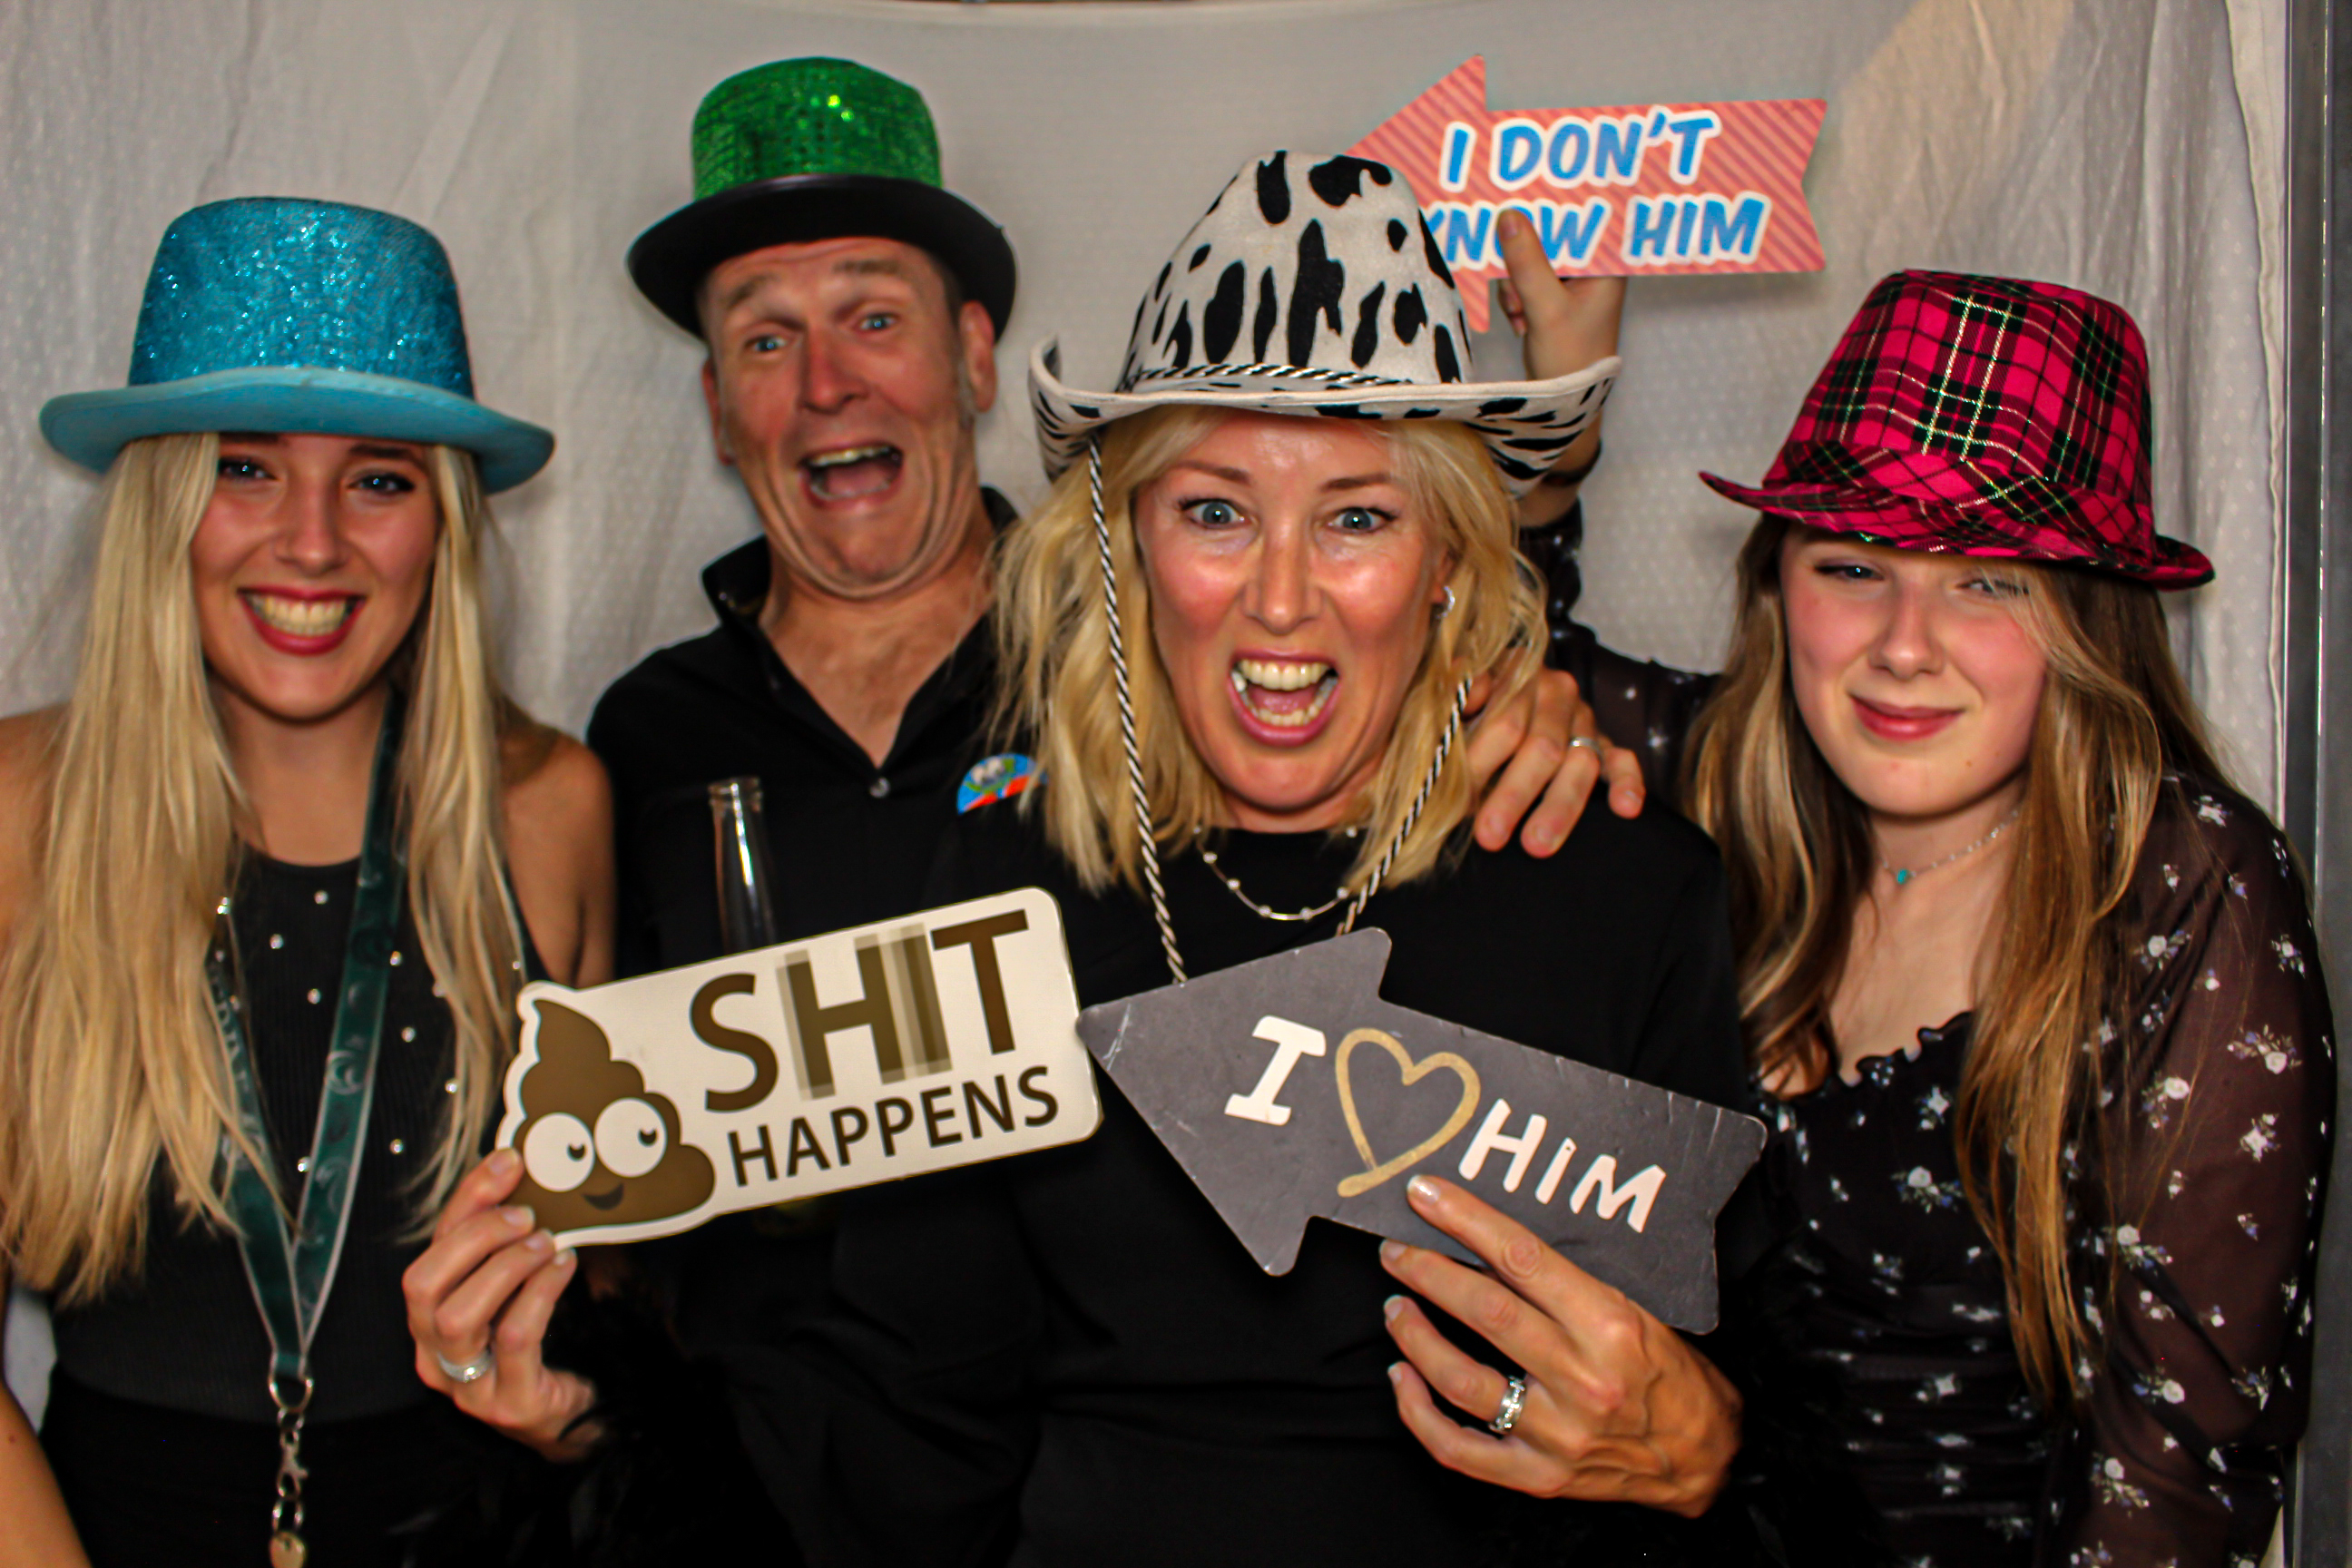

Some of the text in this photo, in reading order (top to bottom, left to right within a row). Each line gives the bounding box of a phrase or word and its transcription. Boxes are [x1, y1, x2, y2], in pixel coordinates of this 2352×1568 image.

[1444, 110, 1716, 185] I DON'T
[1629, 196, 1766, 259] HIM
[689, 907, 1030, 1113] SHIT
[727, 1064, 1059, 1188] HAPPENS
[1223, 1014, 1667, 1234] I HIM
